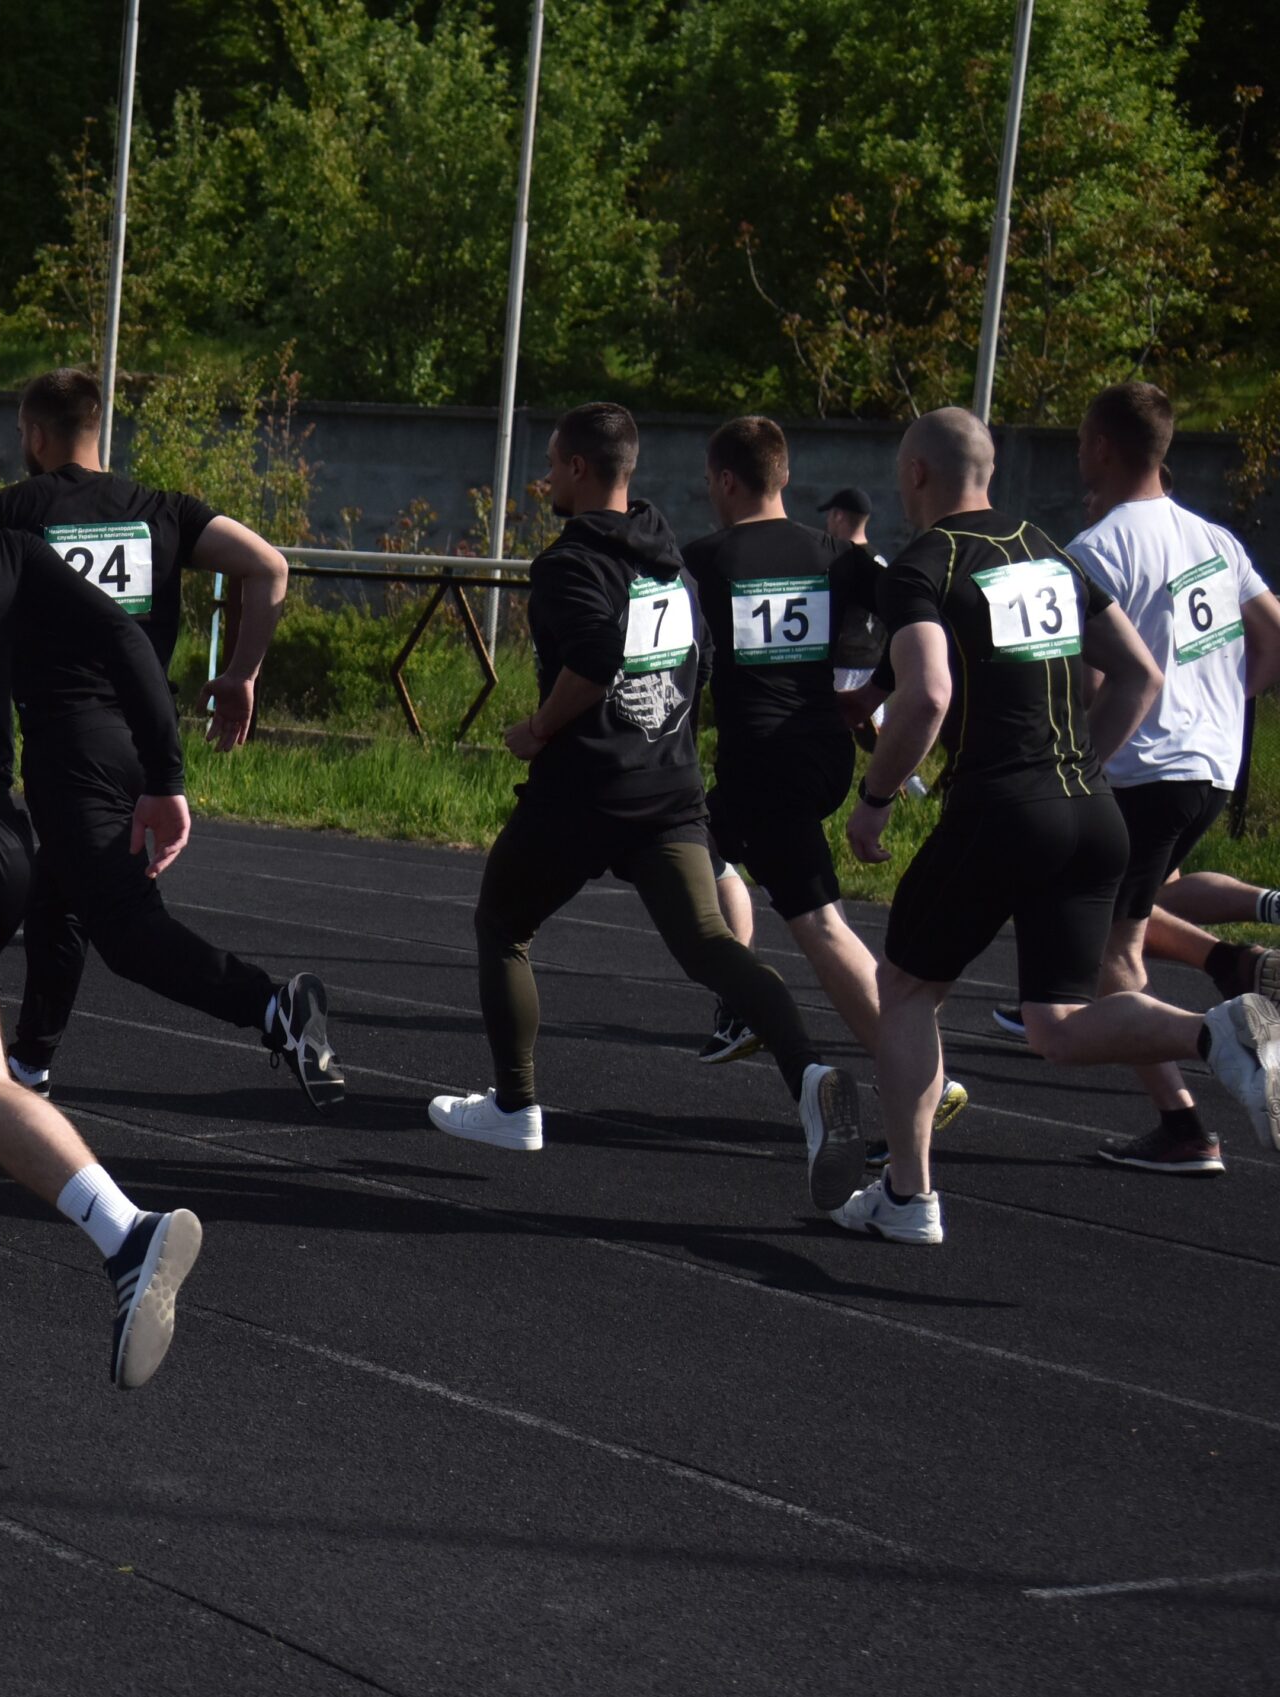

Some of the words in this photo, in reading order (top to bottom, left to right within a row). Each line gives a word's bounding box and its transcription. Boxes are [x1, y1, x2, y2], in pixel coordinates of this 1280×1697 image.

[64, 544, 131, 592] 24
[653, 599, 669, 648] 7
[752, 597, 809, 643] 15
[1008, 586, 1063, 638] 13
[1188, 587, 1213, 632] 6
